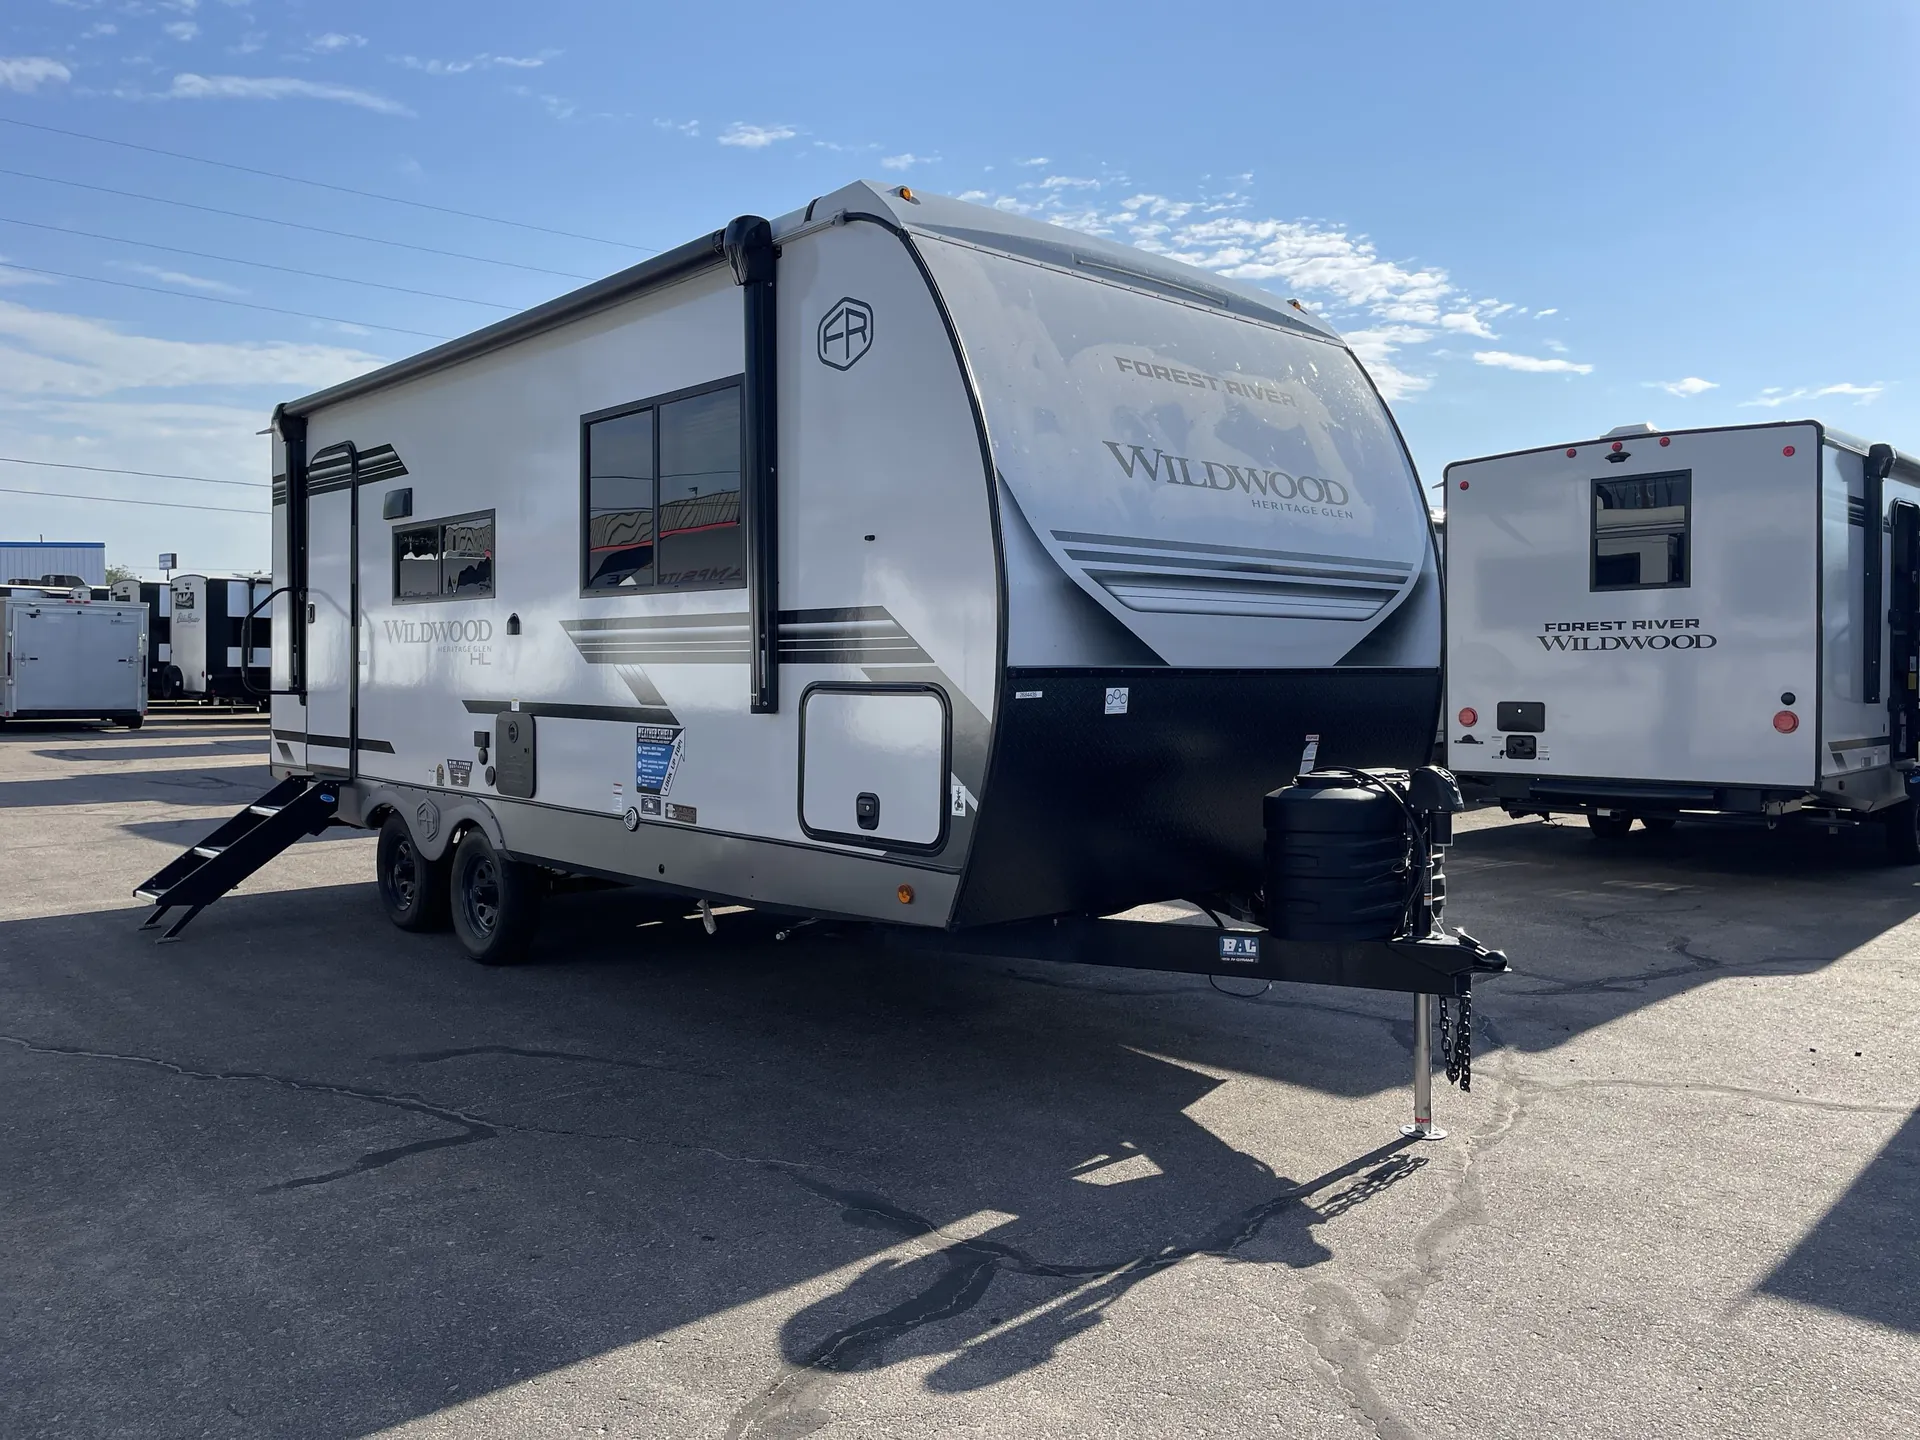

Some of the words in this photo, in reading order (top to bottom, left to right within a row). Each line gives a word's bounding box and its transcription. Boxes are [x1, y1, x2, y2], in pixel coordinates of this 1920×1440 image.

[1113, 355, 1219, 391] FOREST
[1223, 379, 1297, 407] RIVER
[1102, 440, 1349, 506] WILDWOOD
[1251, 499, 1319, 516] HERITAGE
[1322, 507, 1354, 519] GLEN
[383, 619, 493, 644] WILDWOOD
[1544, 621, 1627, 633] FOREST
[1632, 618, 1700, 630] RIVER
[438, 645, 471, 653] HERITAGE
[473, 645, 492, 653] GLEN
[1537, 634, 1718, 652] WILDWOOD
[470, 653, 491, 666] HL
[663, 772, 672, 791] LOOK
[670, 758, 676, 769] UP
